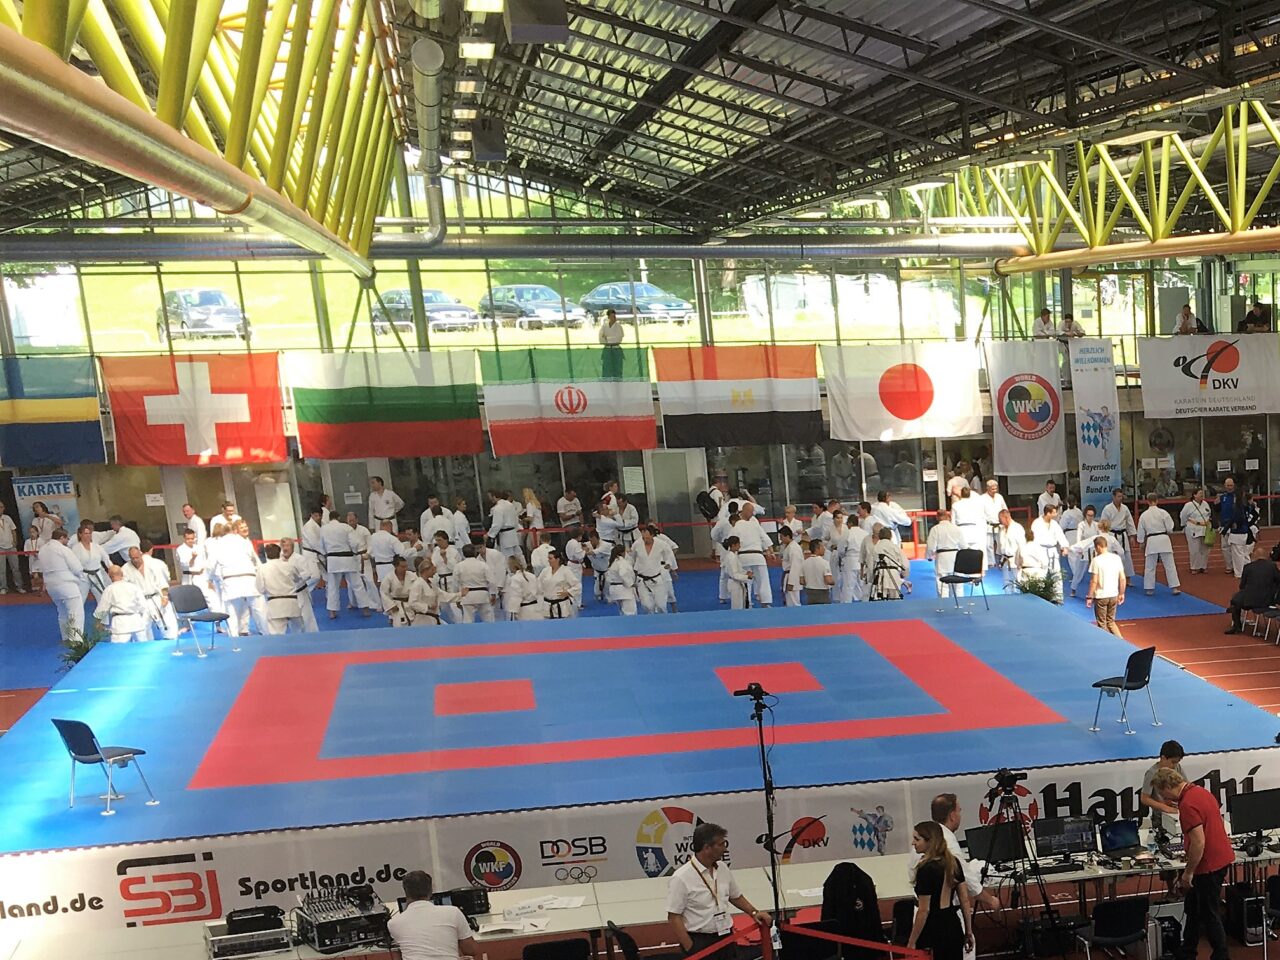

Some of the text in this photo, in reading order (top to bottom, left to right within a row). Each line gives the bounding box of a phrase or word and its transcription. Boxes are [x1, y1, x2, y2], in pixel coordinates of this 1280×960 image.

[1212, 378, 1239, 390] DKV
[1012, 400, 1043, 413] WKF
[1175, 404, 1257, 414] DEUTSCHER KARATE VERBAND
[1081, 463, 1117, 473] Bayerischer
[17, 482, 71, 497] KARATE
[540, 836, 607, 859] DOSB
[802, 837, 830, 848] DKV
[478, 861, 507, 873] WKF
[238, 864, 407, 900] Sportland.de
